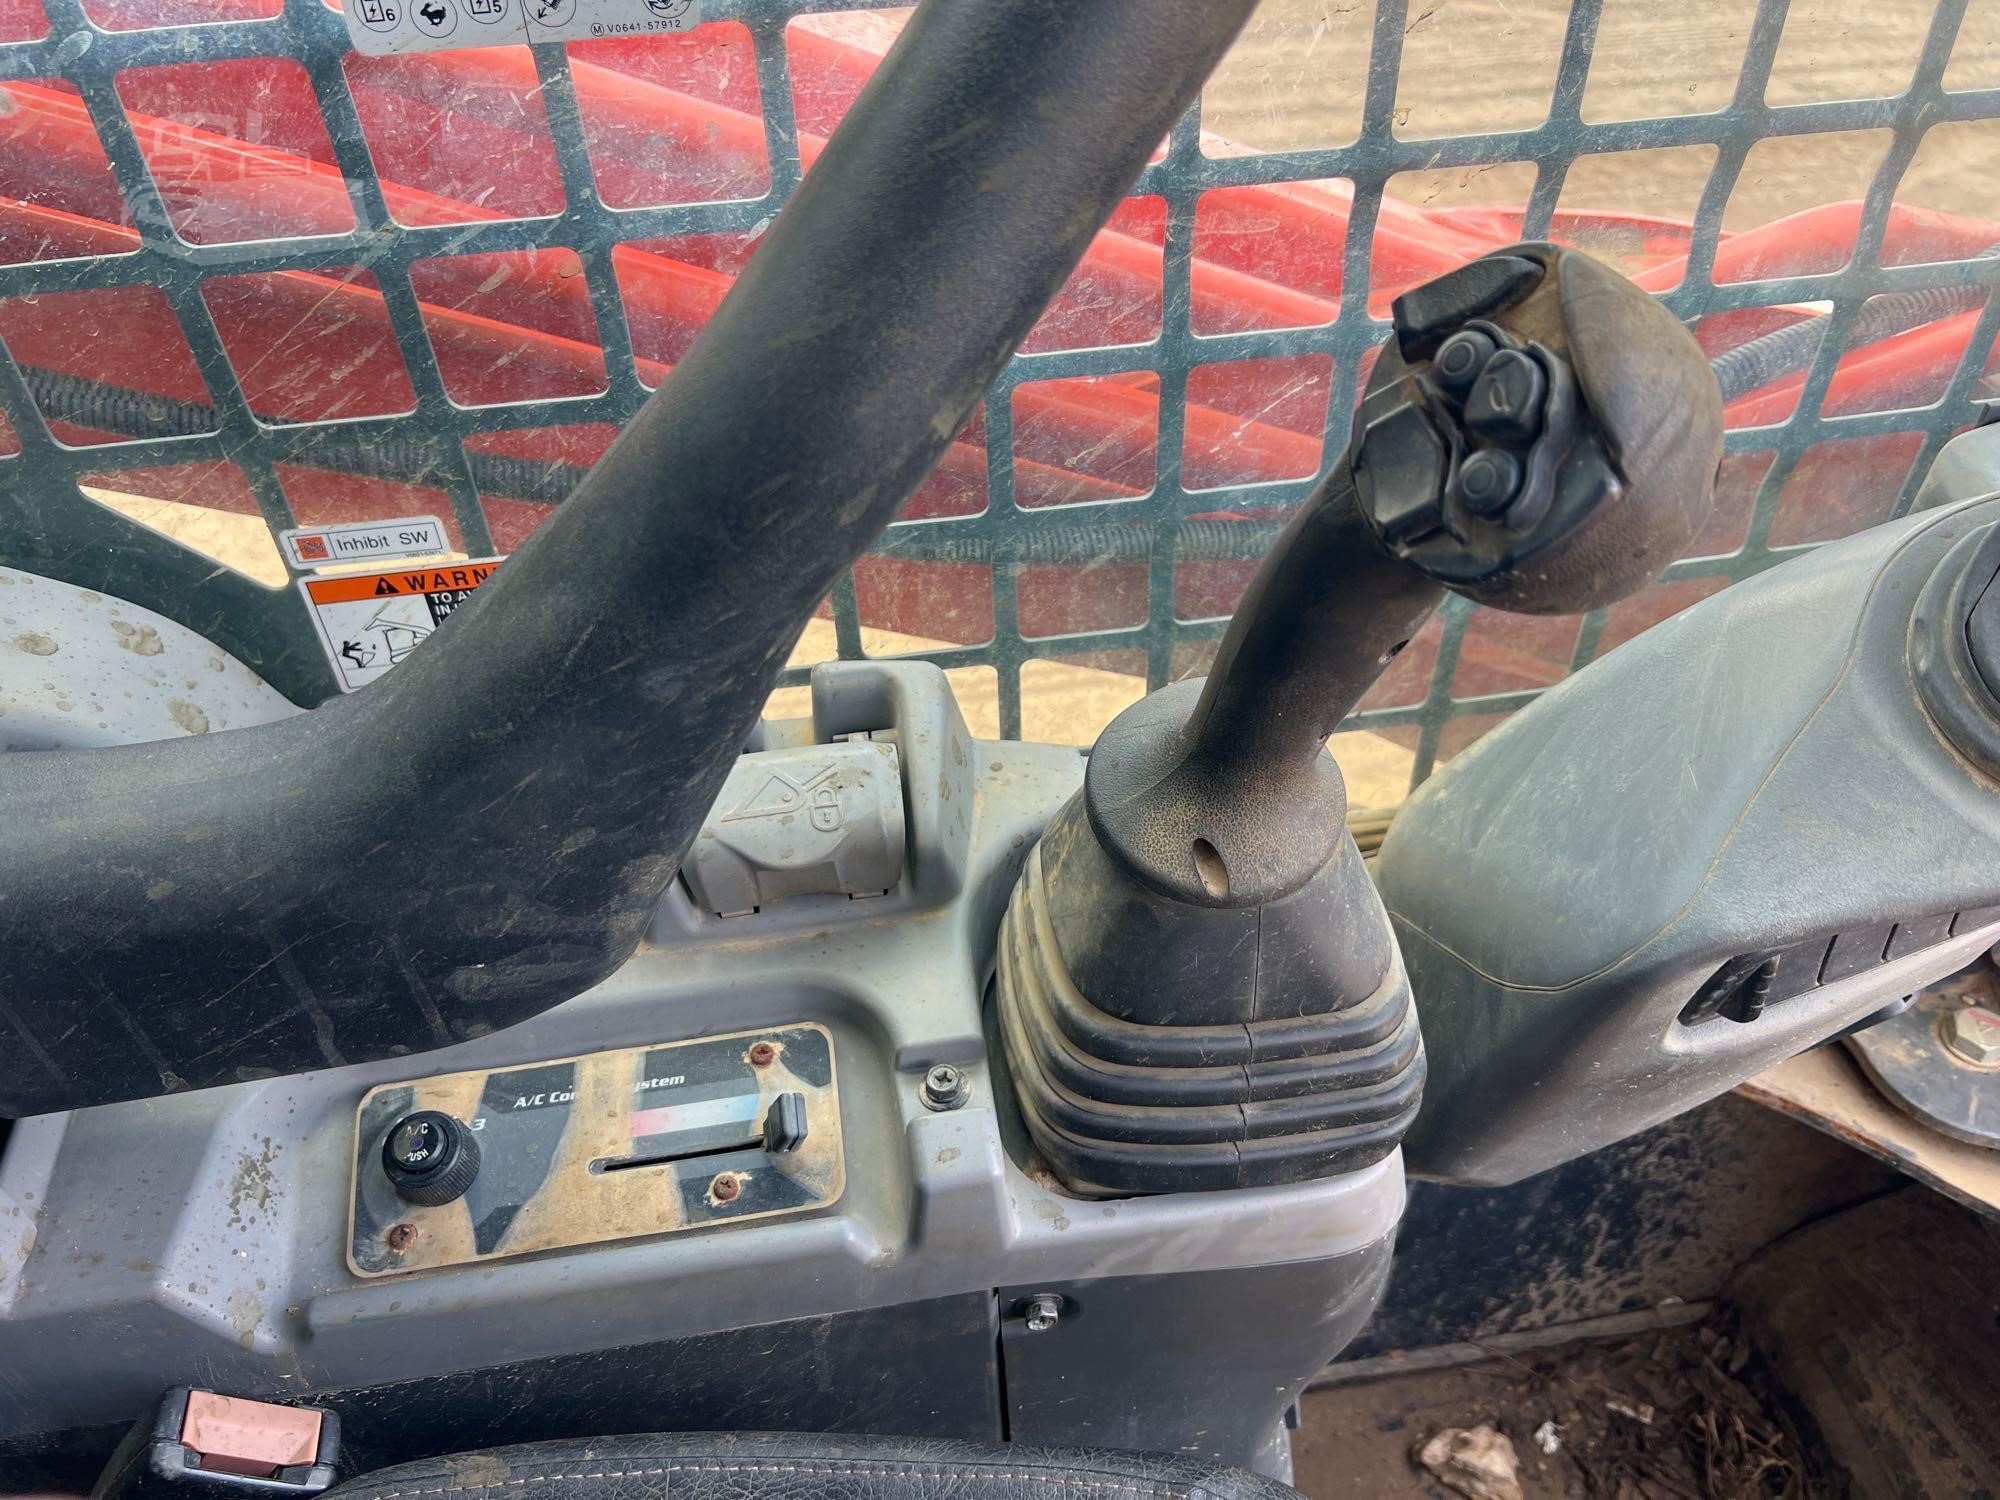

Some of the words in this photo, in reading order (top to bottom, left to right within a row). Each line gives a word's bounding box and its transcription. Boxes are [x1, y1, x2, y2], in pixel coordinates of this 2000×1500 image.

[492, 0, 502, 13] 5
[385, 8, 396, 21] 6
[606, 19, 681, 33] V0641-57912
[336, 535, 391, 551] Inhibit
[399, 530, 428, 545] SW
[403, 568, 496, 591] WARN
[430, 592, 452, 604] TO
[513, 1093, 546, 1108] A/C
[405, 1122, 429, 1137] A/C
